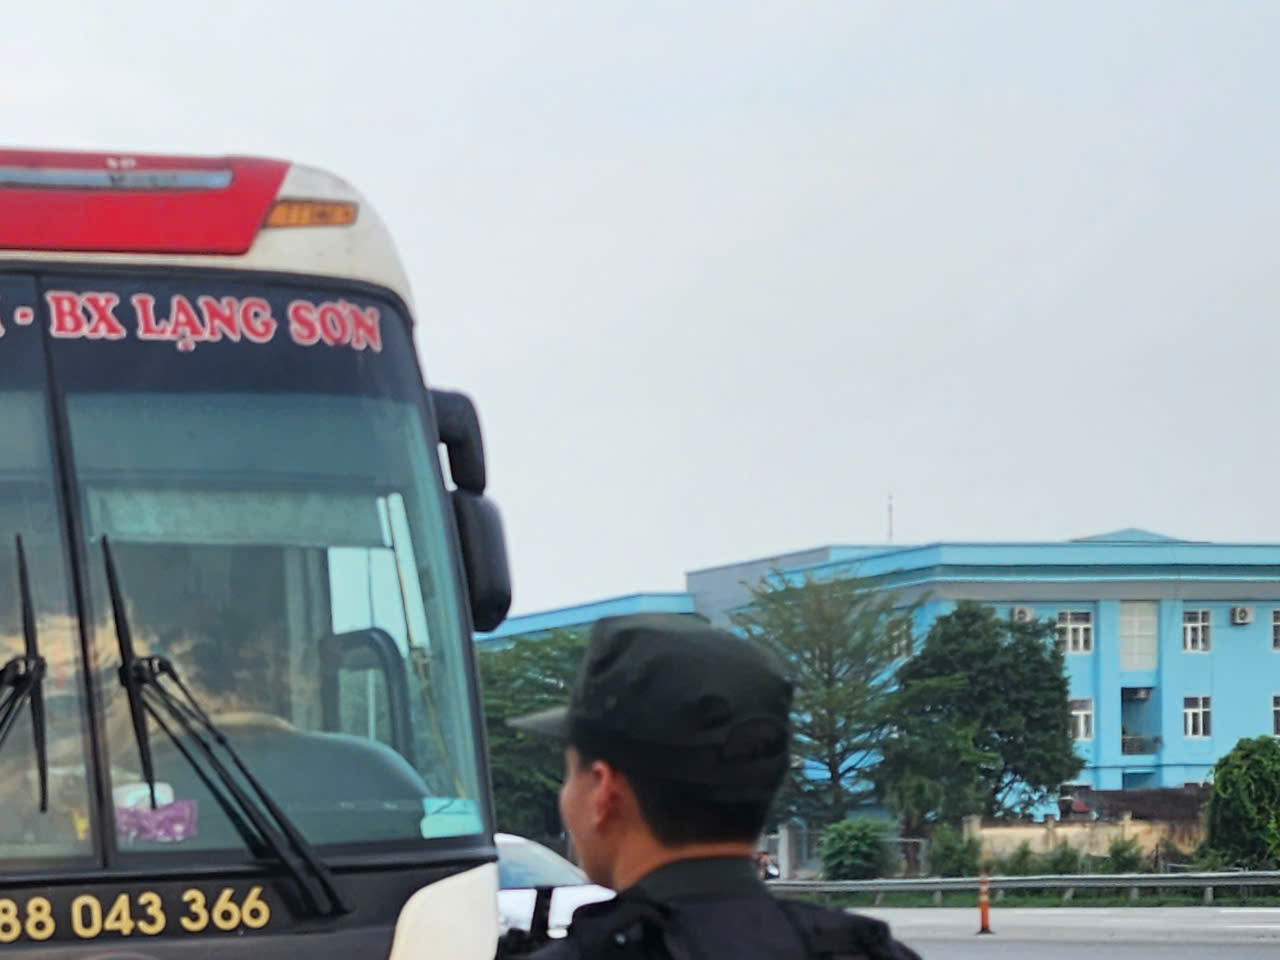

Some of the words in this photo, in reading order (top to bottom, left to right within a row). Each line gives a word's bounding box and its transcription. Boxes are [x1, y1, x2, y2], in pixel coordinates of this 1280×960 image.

[46, 290, 126, 338] BX
[131, 293, 277, 352] LẠNG
[287, 299, 383, 353] SƠN
[70, 891, 167, 939] 043
[180, 886, 271, 932] 366
